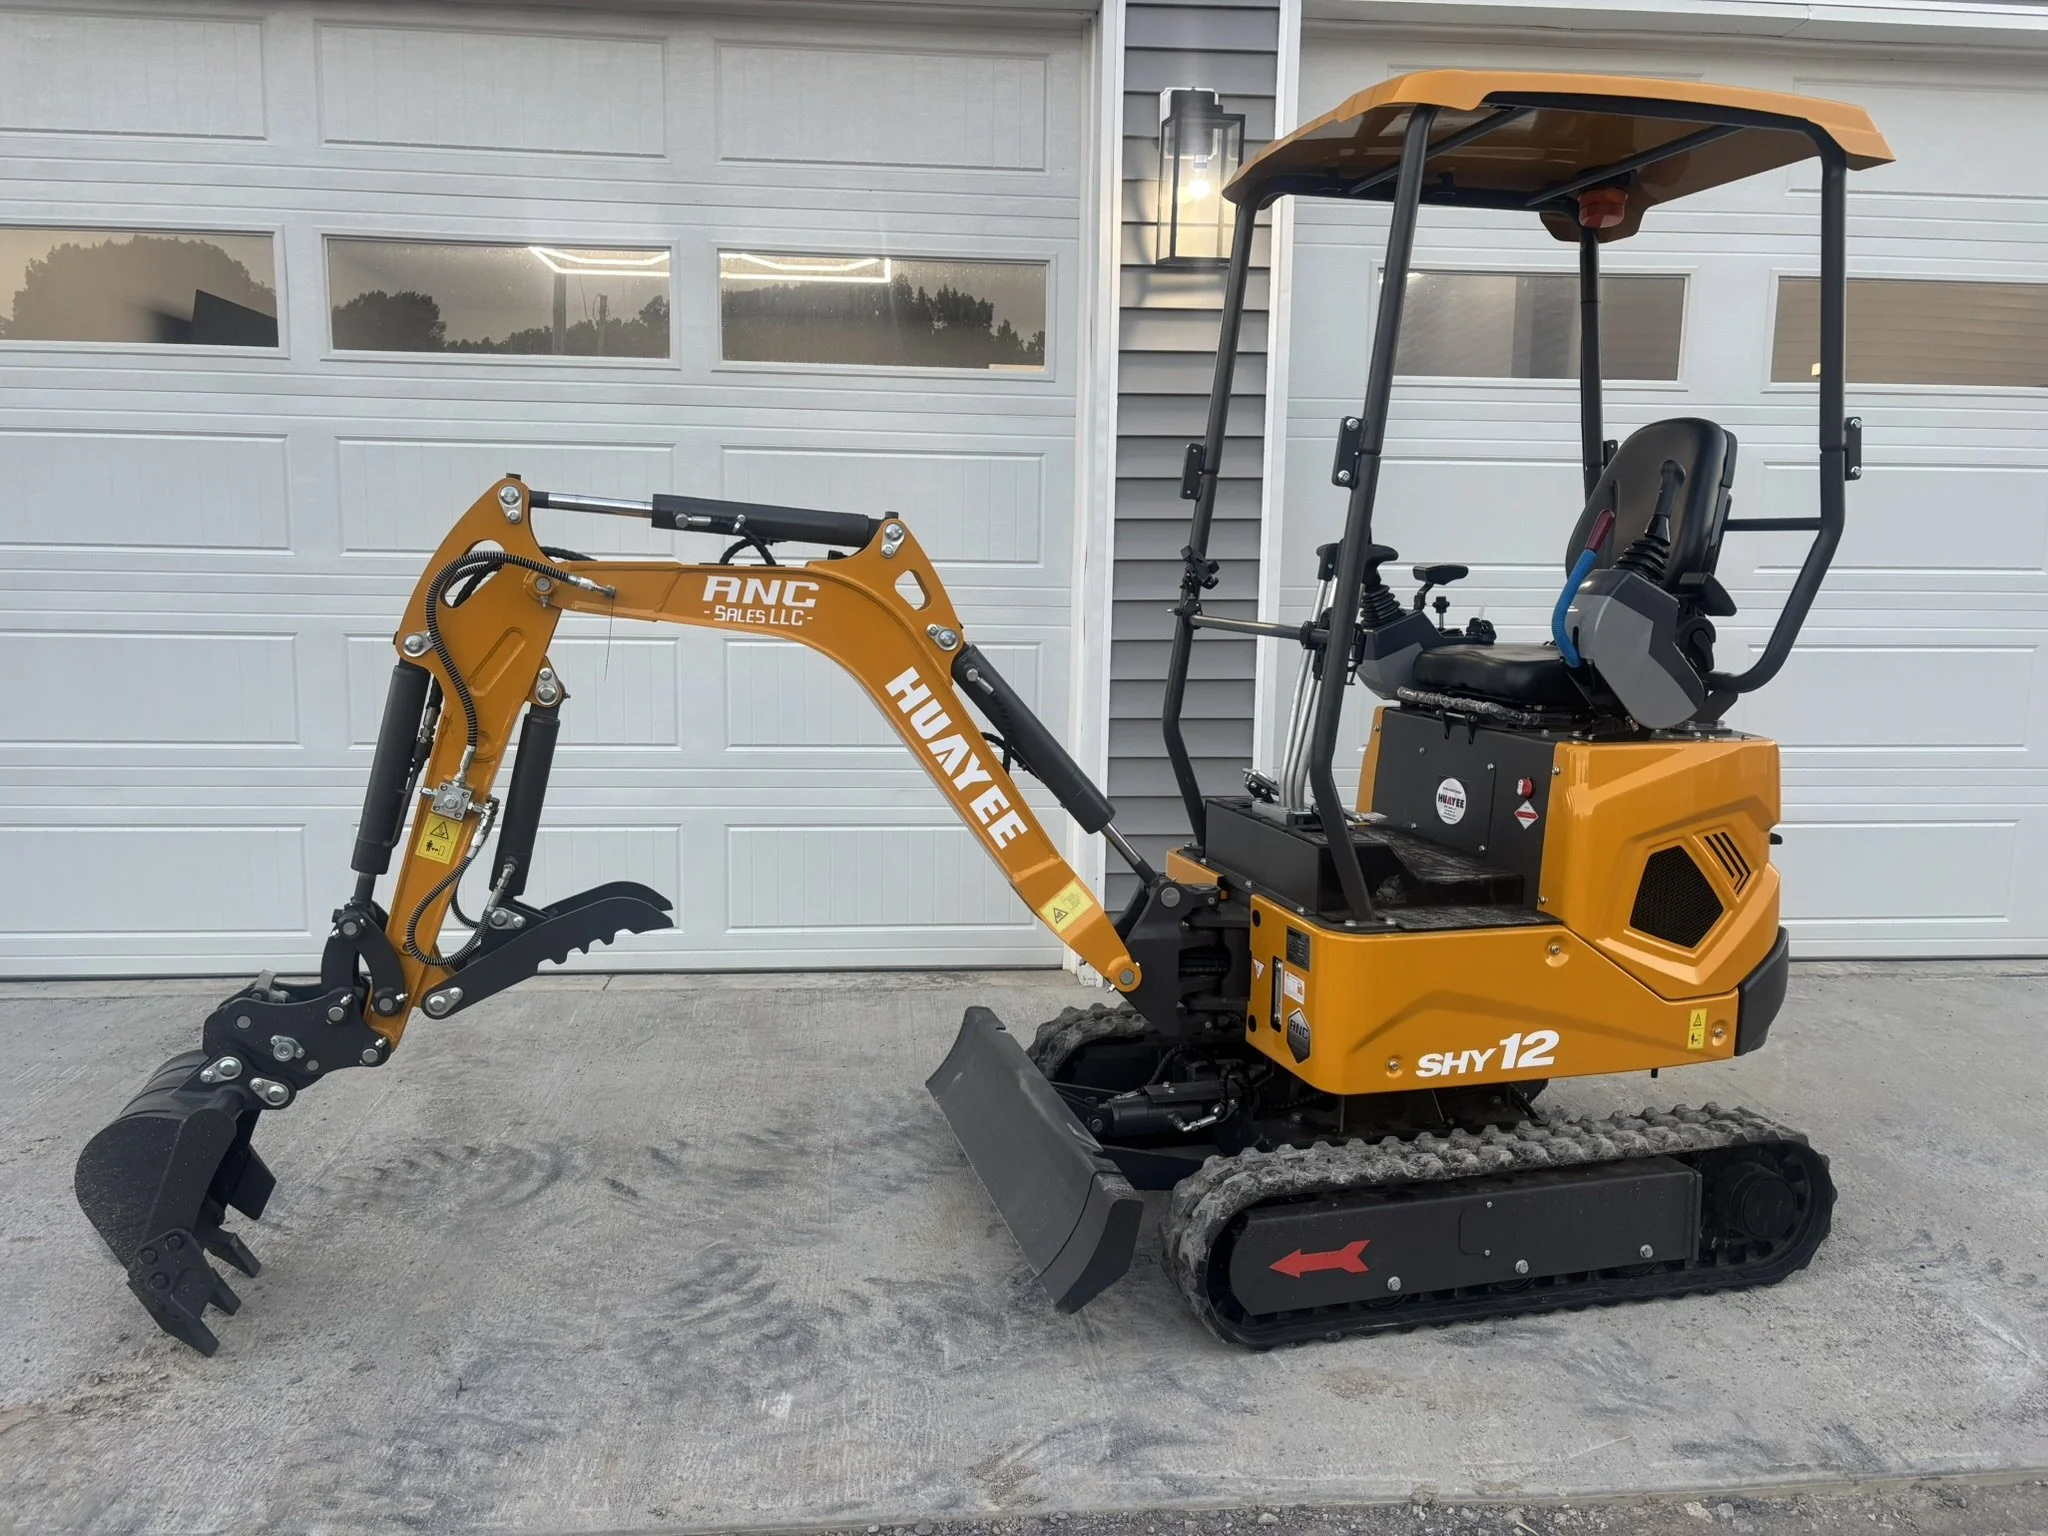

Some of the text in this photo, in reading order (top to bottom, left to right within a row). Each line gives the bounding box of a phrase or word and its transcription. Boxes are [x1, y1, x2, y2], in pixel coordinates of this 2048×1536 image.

[702, 575, 820, 608] ANC
[885, 666, 1028, 849] HUAYEE
[1437, 793, 1465, 808] HUAYEE
[1415, 1029, 1560, 1078] SHY 12
